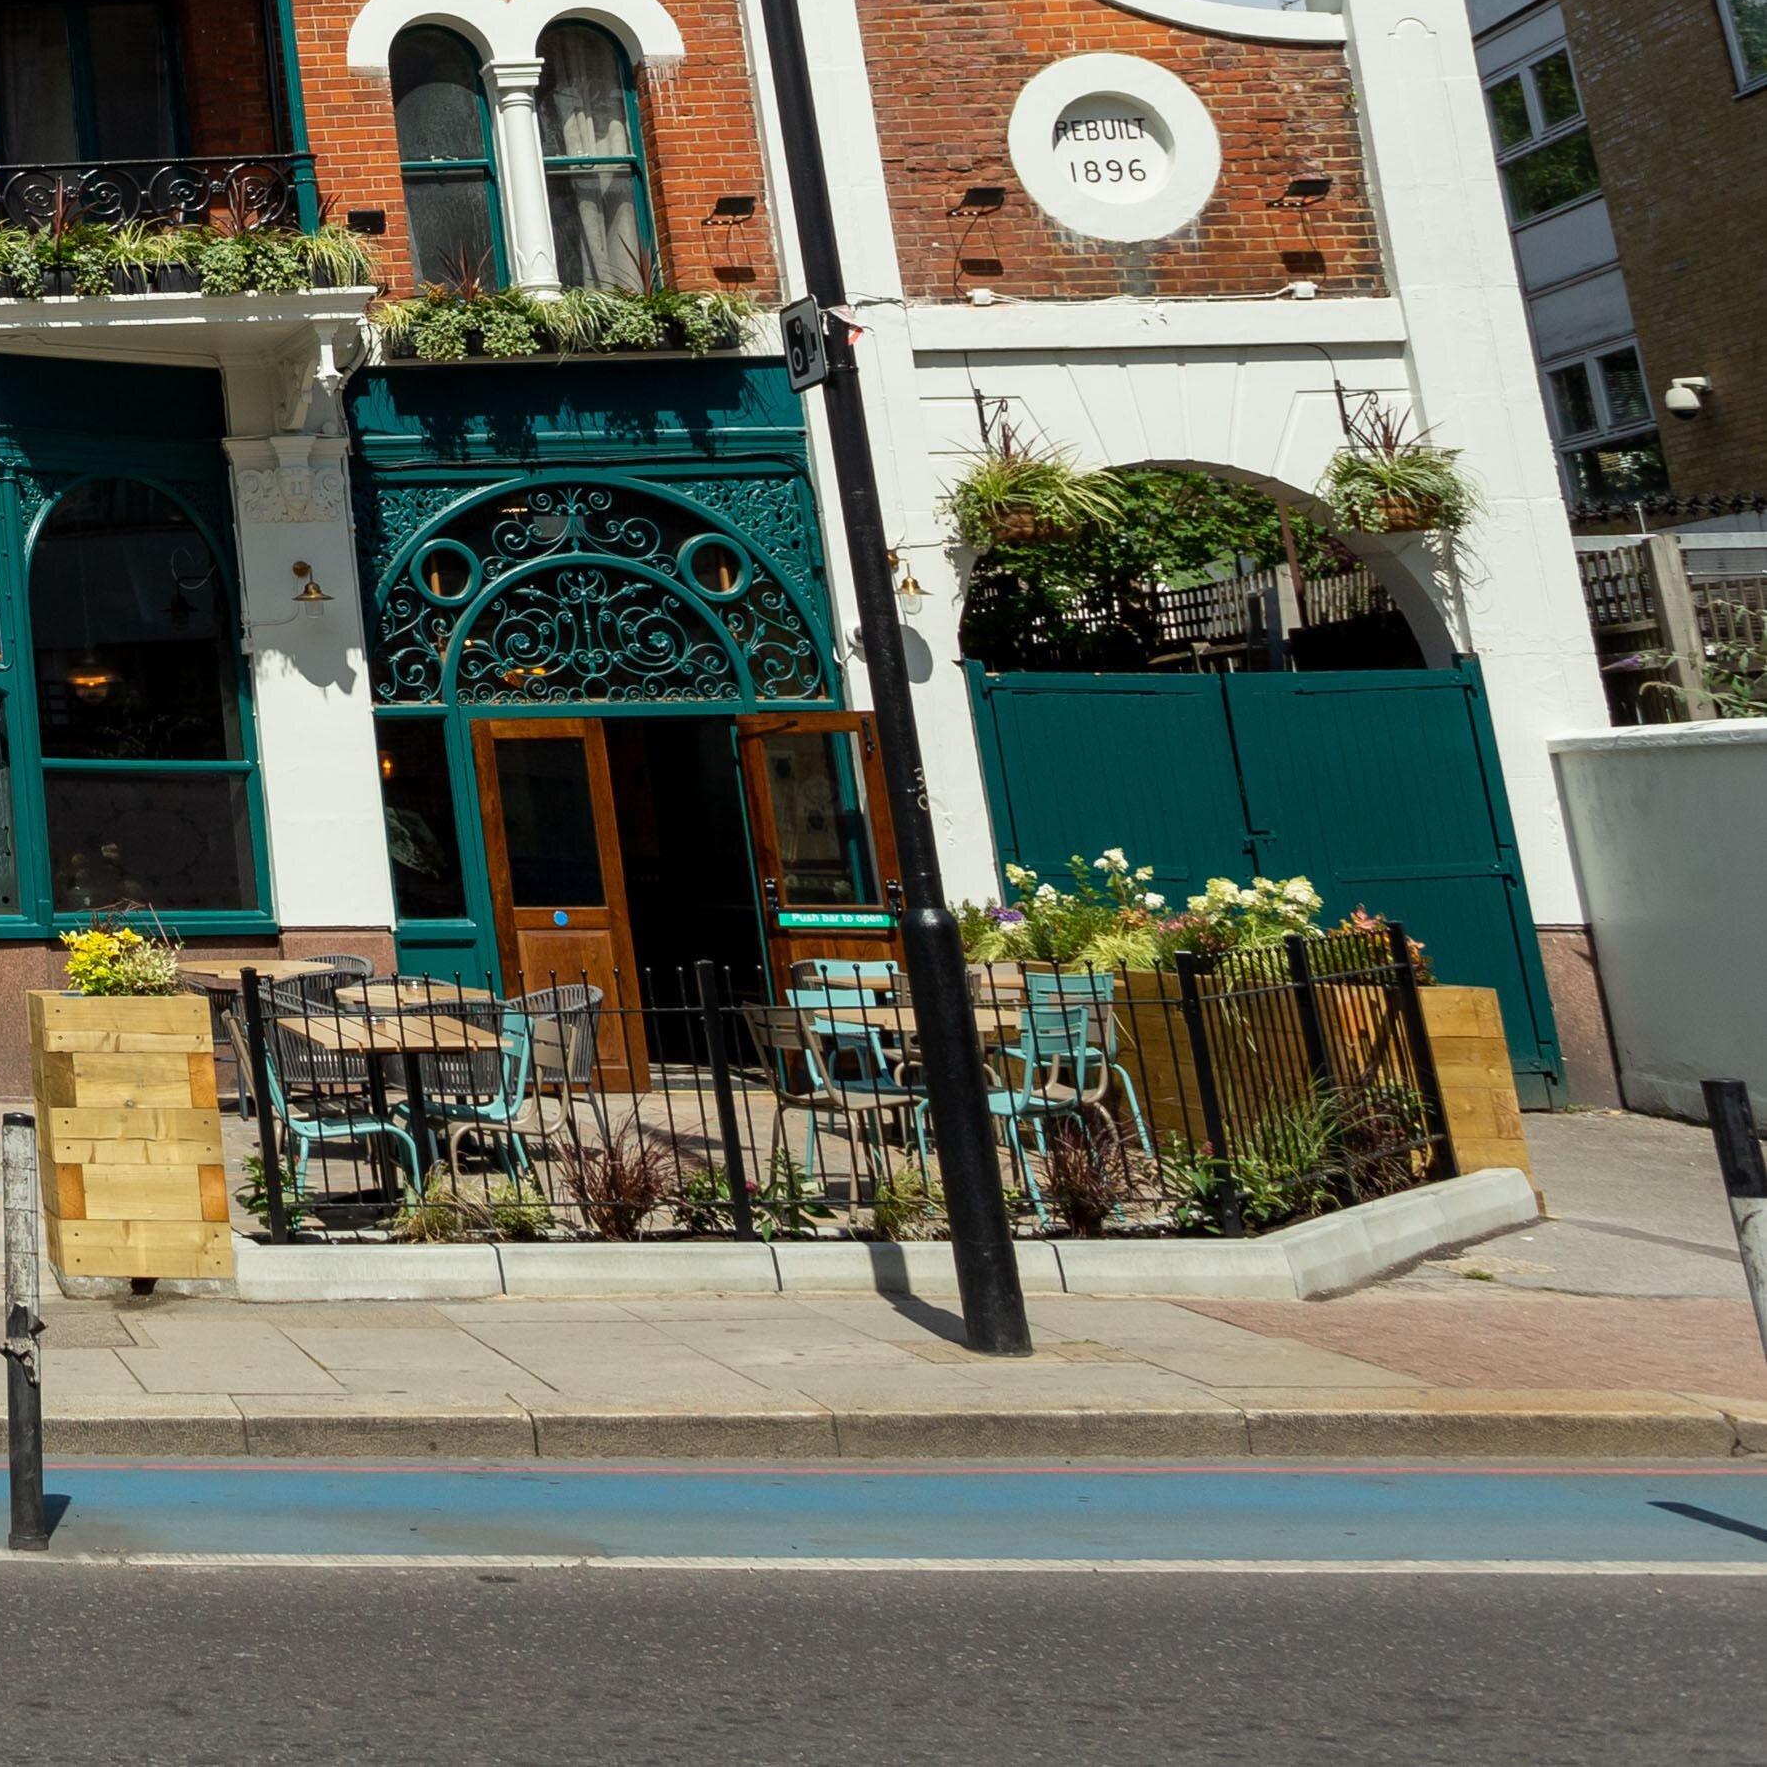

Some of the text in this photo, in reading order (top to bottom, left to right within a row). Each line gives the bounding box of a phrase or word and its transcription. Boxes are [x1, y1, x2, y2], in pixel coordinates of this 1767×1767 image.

[1053, 117, 1146, 142] REBUILT
[1069, 158, 1147, 183] 1896
[791, 913, 884, 925] Push bar to open
